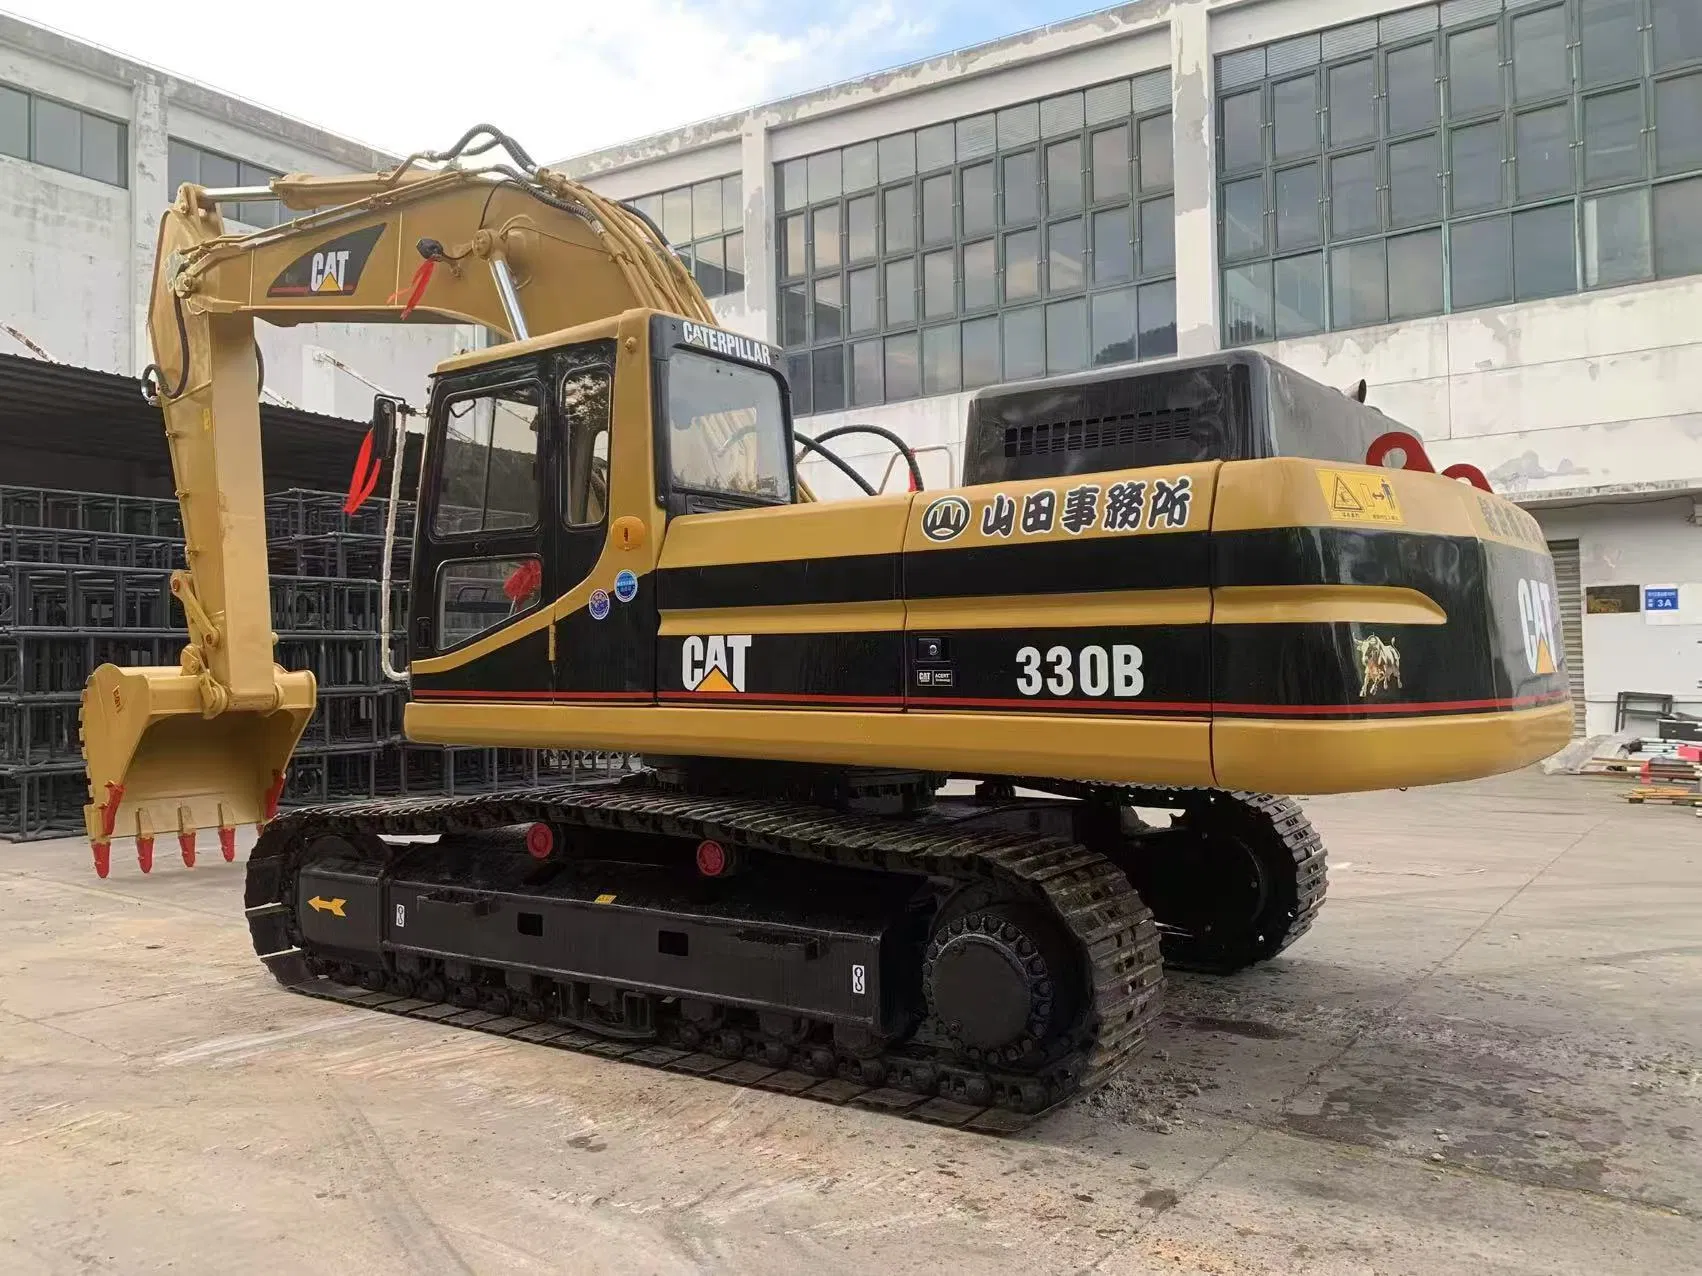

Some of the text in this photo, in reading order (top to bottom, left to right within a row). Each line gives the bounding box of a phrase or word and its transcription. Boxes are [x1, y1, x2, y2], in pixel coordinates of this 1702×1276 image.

[310, 250, 350, 291] CAT
[682, 321, 772, 366] CATERPILLAR
[979, 475, 1193, 538] 山田事務所
[1517, 578, 1559, 674] CAT
[1657, 599, 1672, 607] 3A
[682, 635, 752, 692] CAT
[919, 672, 931, 680] CAT
[1015, 644, 1145, 697] 330B
